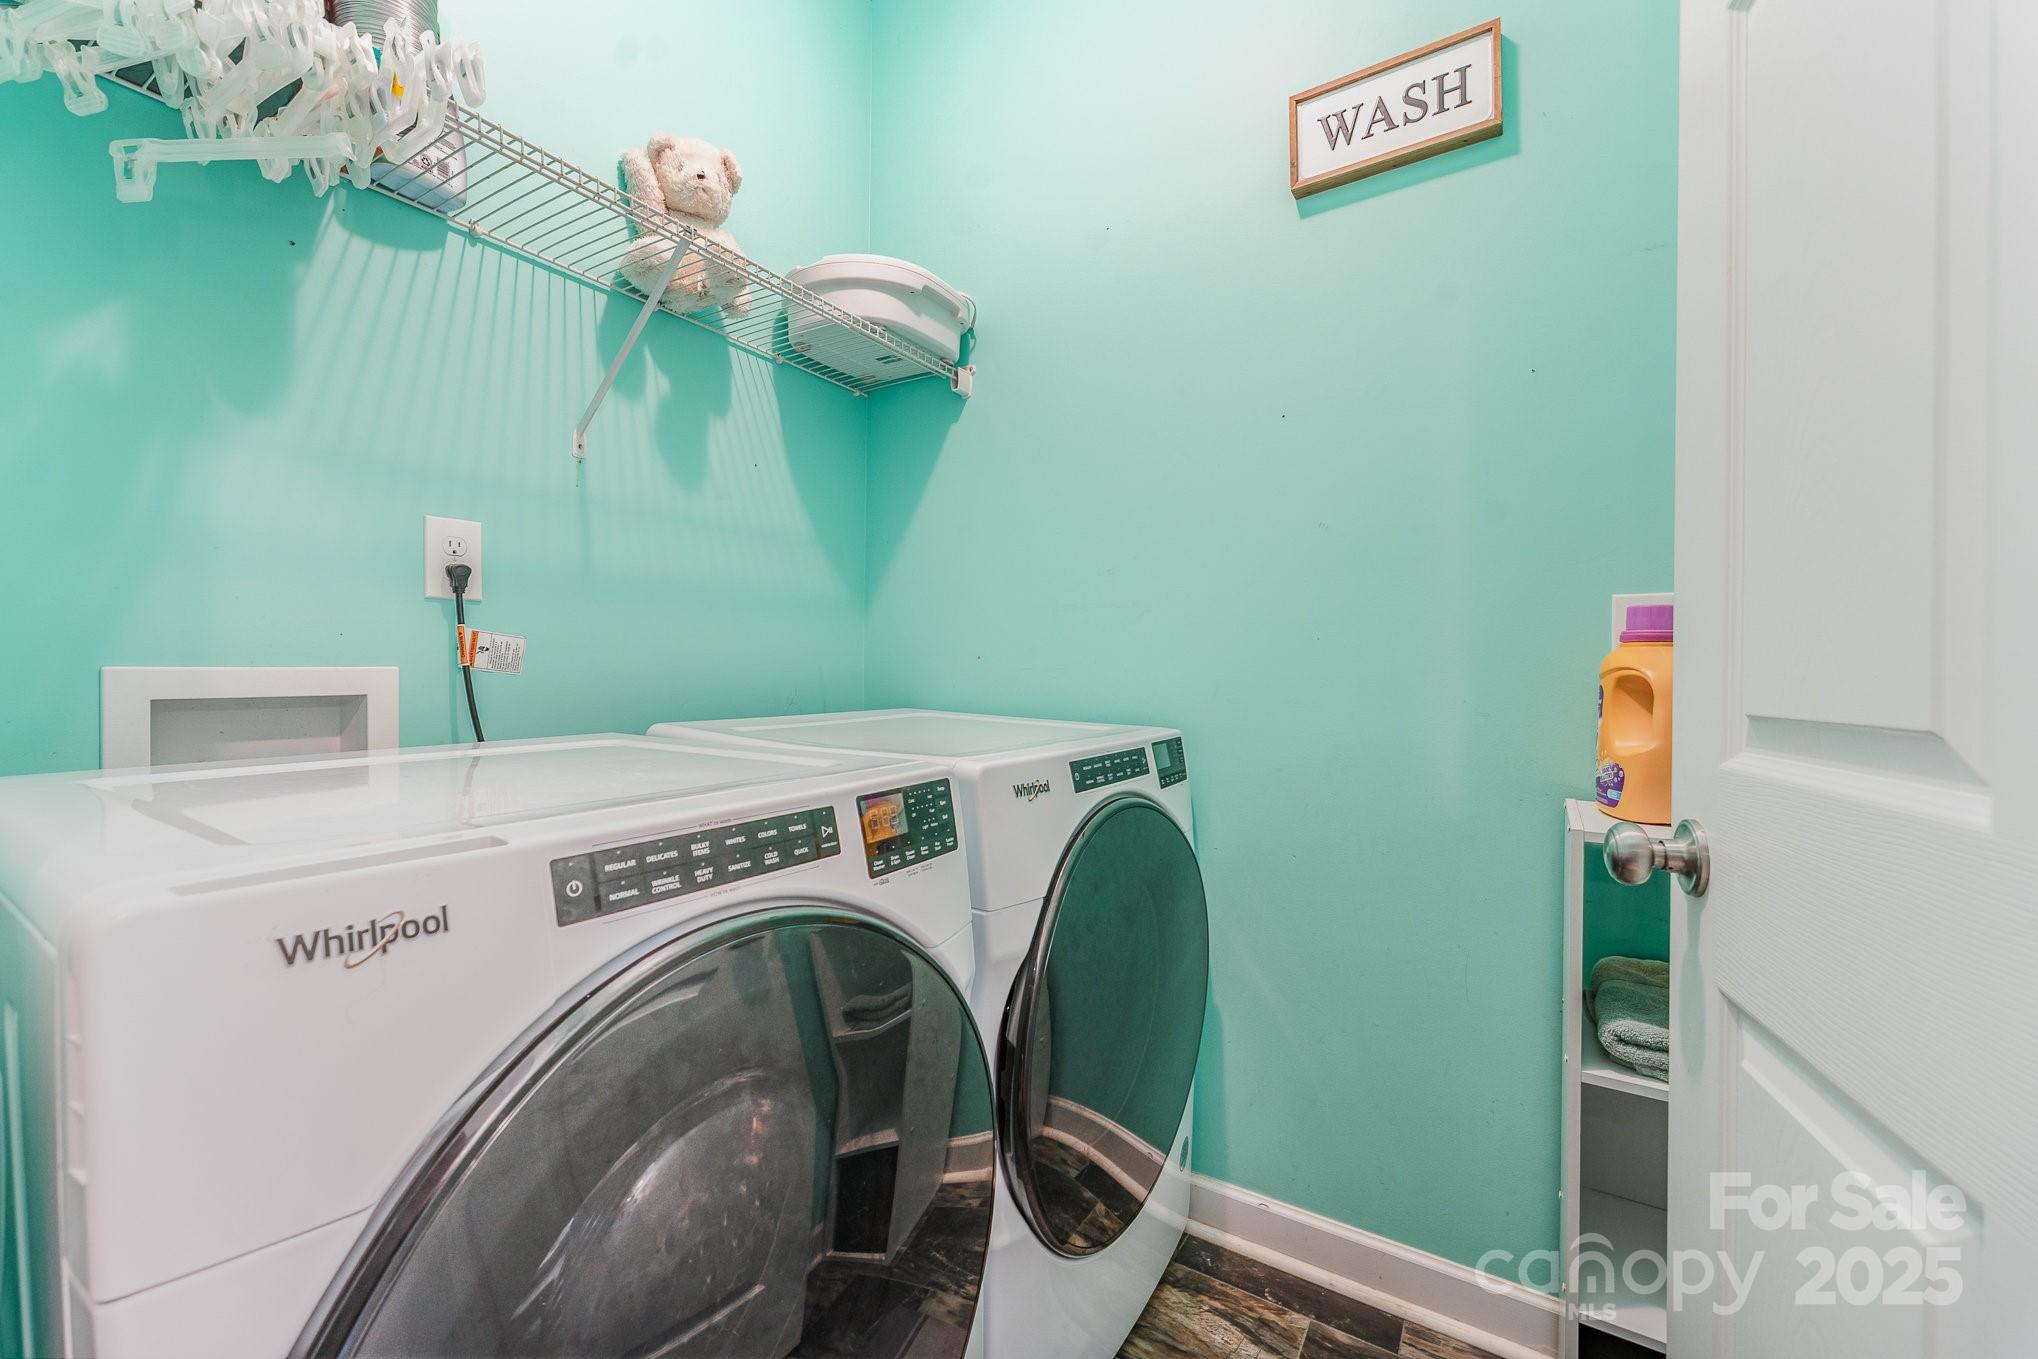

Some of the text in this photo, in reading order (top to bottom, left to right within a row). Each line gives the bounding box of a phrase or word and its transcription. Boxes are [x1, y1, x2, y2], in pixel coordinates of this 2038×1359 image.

[1317, 64, 1472, 151] WASH
[1013, 780, 1050, 799] Whirlpool
[788, 823, 807, 833] TOWELS
[757, 829, 778, 839] COLORS
[690, 841, 710, 851] BULKY
[725, 835, 746, 846] WHITES
[645, 850, 679, 863] DELICATES
[692, 847, 711, 857] ITEMS
[764, 851, 779, 860] COLD
[793, 846, 809, 856] QUICK
[604, 859, 637, 872] REGULAR
[727, 860, 752, 872] SANITIZE
[764, 857, 780, 866] WASH
[694, 866, 714, 877] HEAVY
[650, 874, 680, 887] WRINKLE
[696, 873, 714, 883] DUTY
[651, 882, 682, 895] CONTROL
[608, 888, 640, 901] NORMAL
[275, 904, 449, 966] Whirlpool
